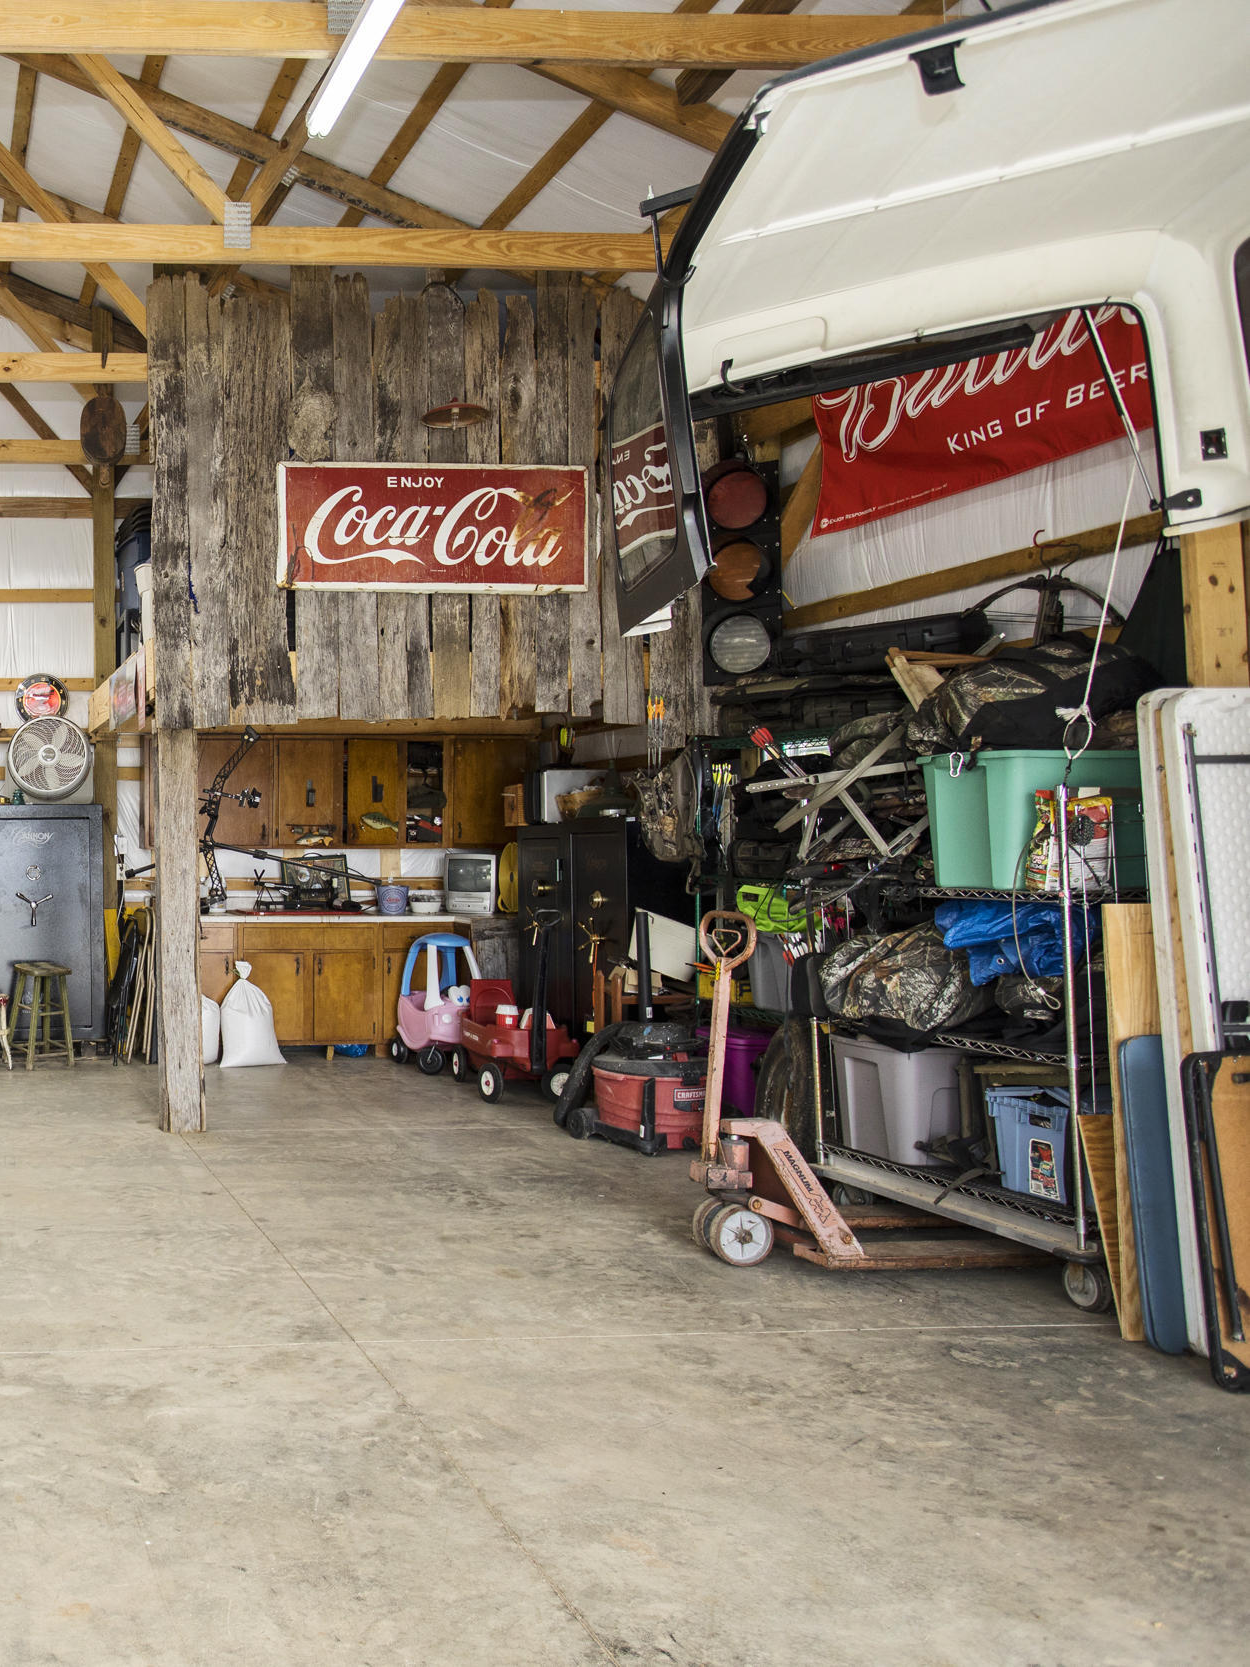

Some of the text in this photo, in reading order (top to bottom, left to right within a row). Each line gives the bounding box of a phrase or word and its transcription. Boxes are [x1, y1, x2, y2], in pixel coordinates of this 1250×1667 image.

[946, 418, 1003, 455] KING
[1015, 400, 1051, 427] OF
[386, 476, 445, 489] ENJOY
[303, 485, 565, 567] Coca-Cola
[783, 1150, 813, 1193] MAGNUM
